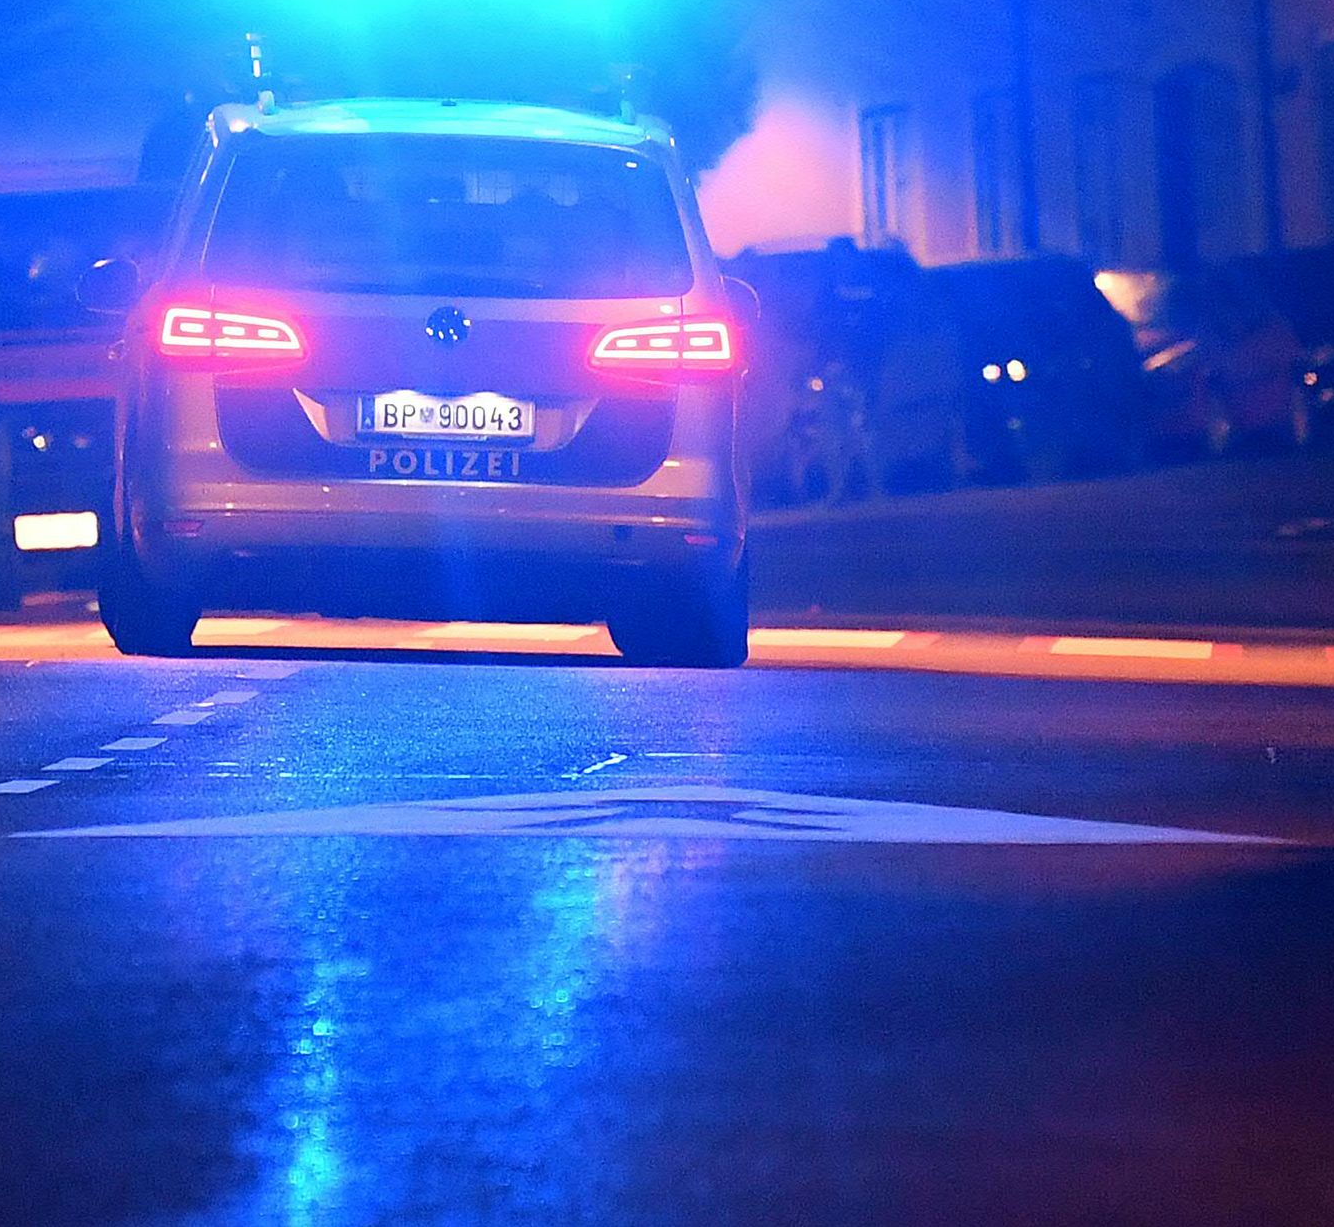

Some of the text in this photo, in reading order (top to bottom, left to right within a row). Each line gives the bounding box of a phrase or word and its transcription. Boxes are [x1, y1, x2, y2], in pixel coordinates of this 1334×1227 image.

[383, 403, 416, 429] BP
[438, 404, 522, 431] 90043
[369, 449, 520, 477] POLIZEI
